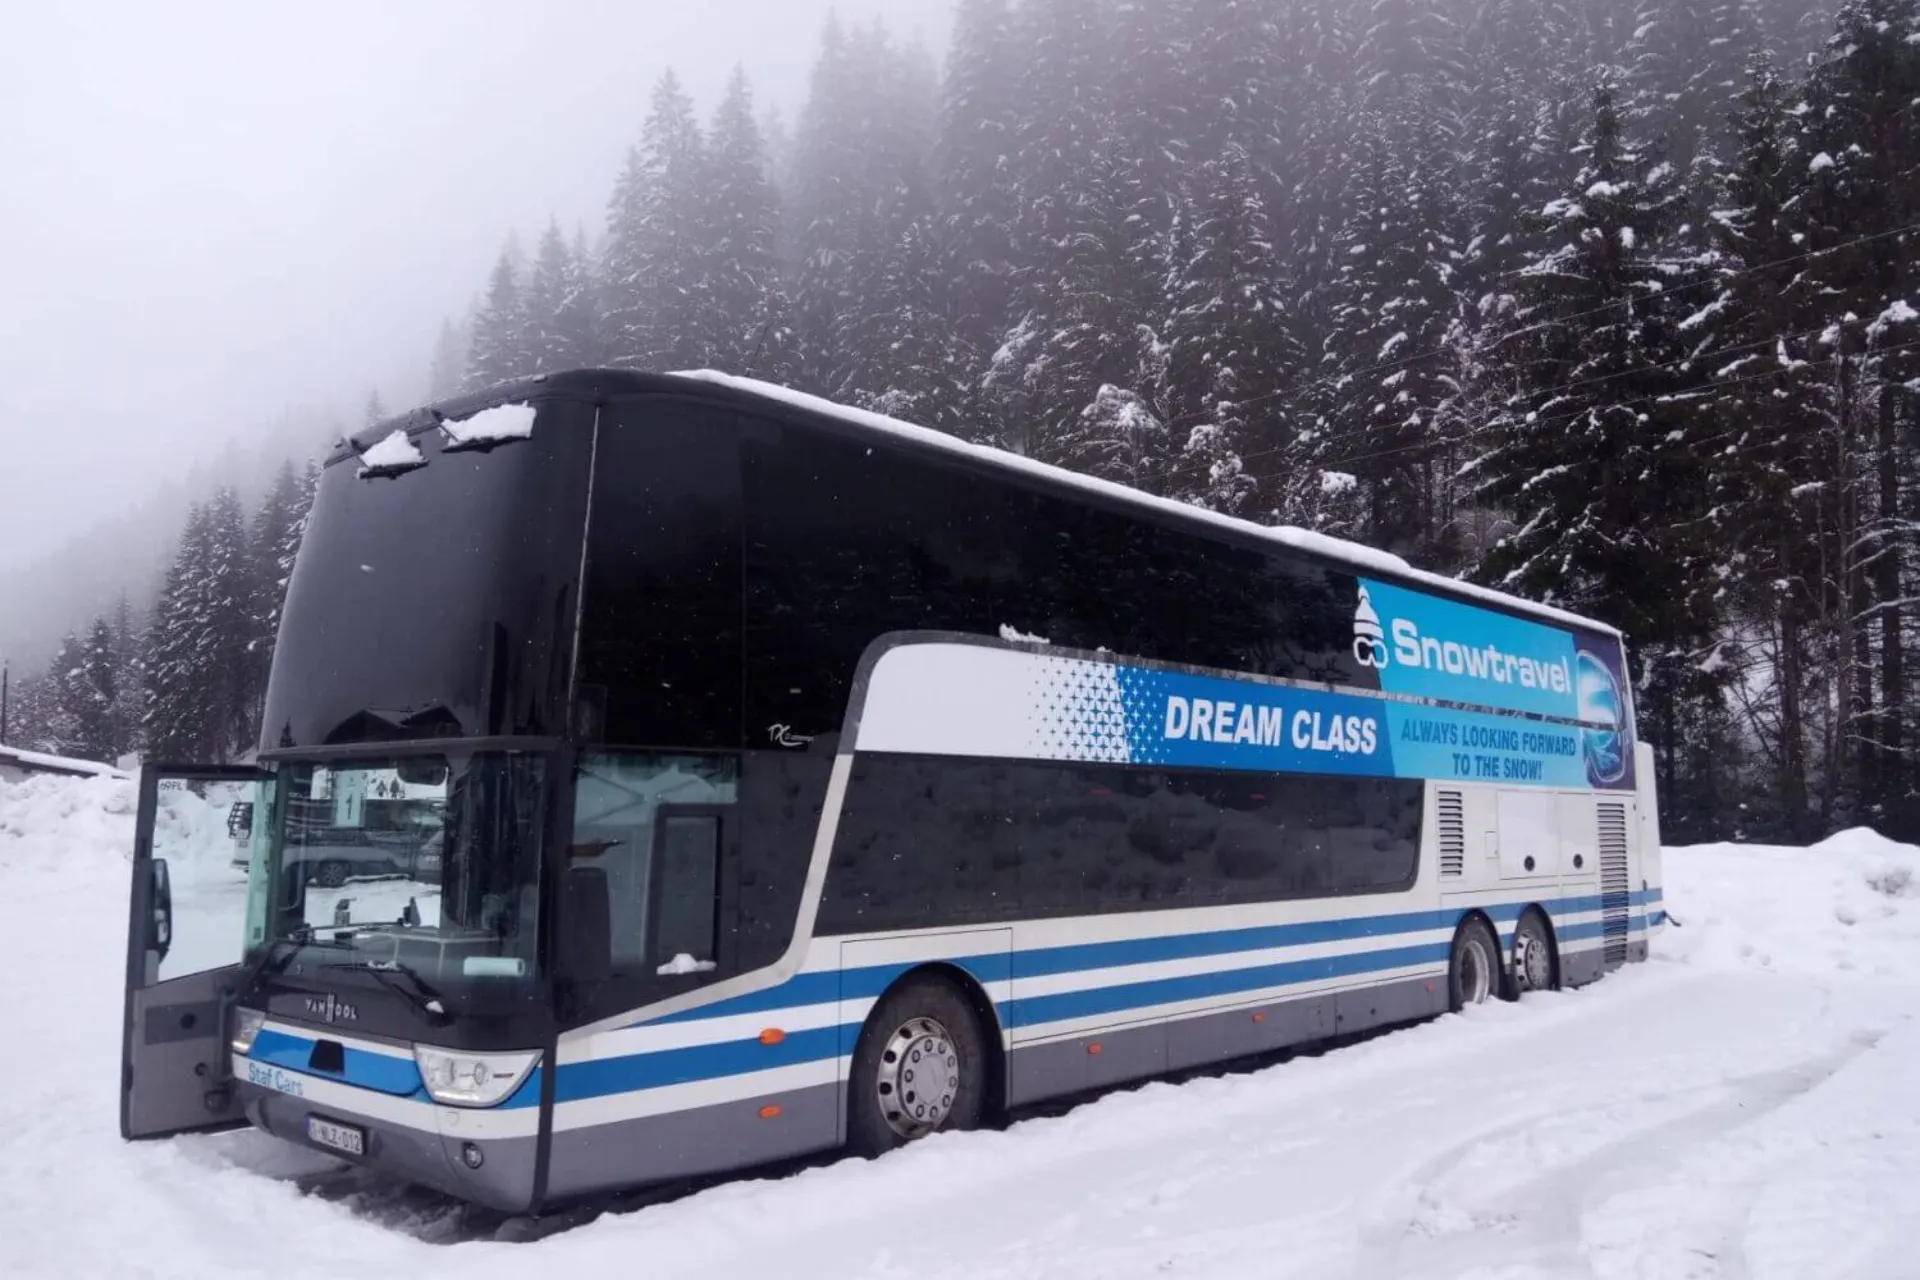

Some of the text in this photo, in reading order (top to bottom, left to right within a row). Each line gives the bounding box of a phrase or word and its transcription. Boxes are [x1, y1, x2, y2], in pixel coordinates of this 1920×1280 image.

[1391, 617, 1572, 694] Snowtravel
[1164, 695, 1378, 756] DREAM CLASS
[1400, 718, 1577, 757] ALWAYS LOOKING FORWARD
[1452, 752, 1543, 780] TO THE SNOW!
[248, 1062, 272, 1087] Staf
